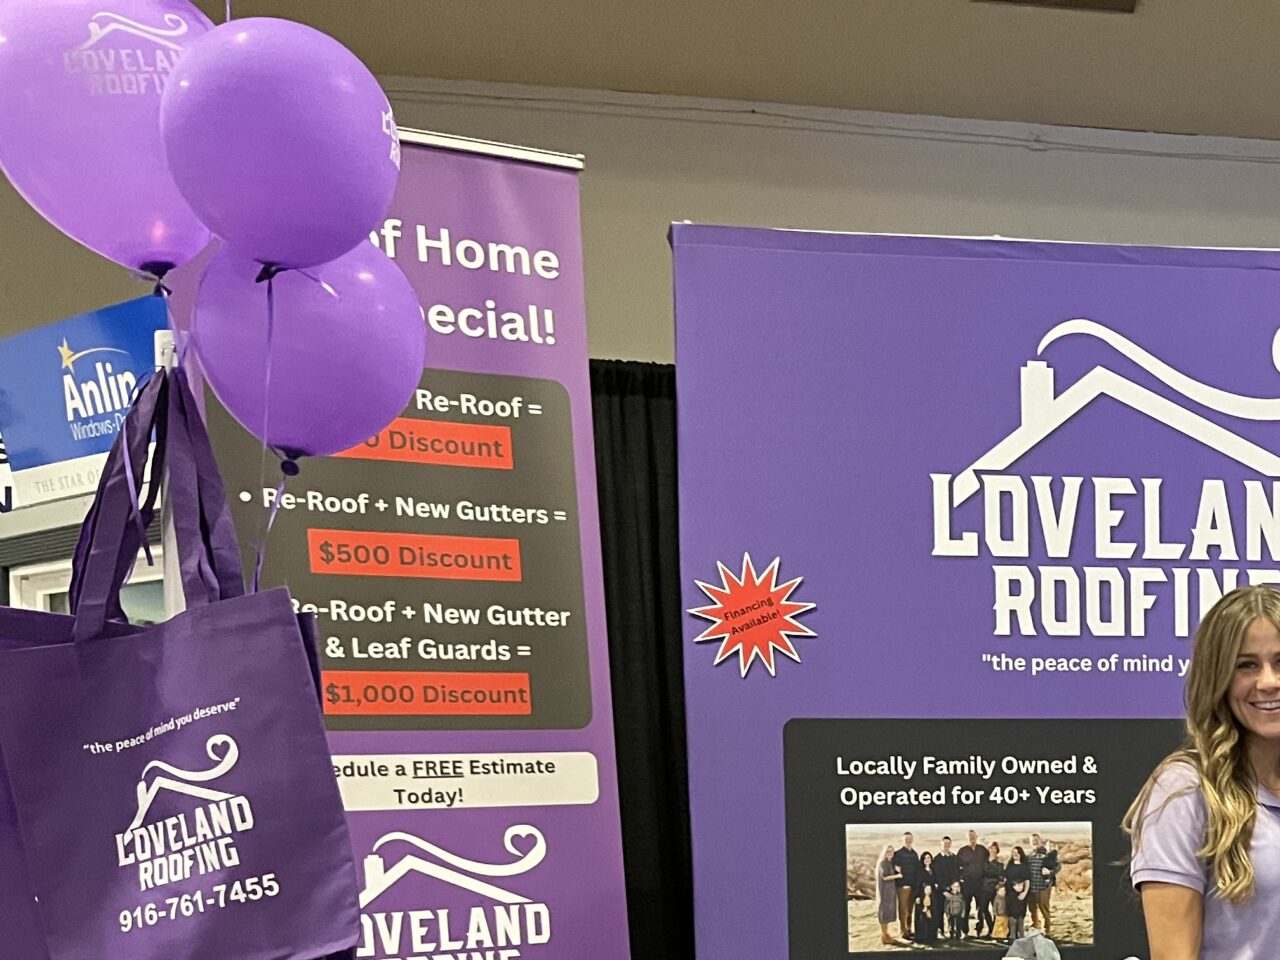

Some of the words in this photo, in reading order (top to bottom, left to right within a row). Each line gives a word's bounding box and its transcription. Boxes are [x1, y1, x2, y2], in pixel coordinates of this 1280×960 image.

[416, 224, 560, 279] Home
[419, 300, 556, 345] ecial!
[63, 361, 139, 421] Anlin
[415, 389, 522, 418] Re-Roof
[389, 430, 505, 458] Discount
[262, 487, 369, 514] Re-Roof
[395, 496, 450, 519] New
[456, 500, 550, 525] Gutters
[319, 540, 391, 566] $500
[399, 545, 514, 572] Discount
[423, 602, 480, 626] New
[487, 604, 571, 628] Gutter
[723, 596, 775, 622] Financing
[730, 609, 781, 636] Available!
[325, 636, 345, 660] &
[352, 636, 411, 660] Leaf
[418, 638, 511, 662] Guards
[1031, 656, 1094, 676] peace
[1097, 653, 1119, 673] of
[1122, 653, 1174, 673] mind
[326, 682, 416, 708] $1,000
[423, 684, 528, 707] Discount
[115, 733, 146, 753] peace
[145, 727, 155, 741] of
[153, 717, 176, 738] mind
[175, 711, 193, 731] you
[395, 764, 407, 777] a
[412, 760, 464, 780] FREE
[469, 758, 556, 776] Estimate
[836, 755, 917, 780] Locally
[922, 755, 996, 780] Family
[1001, 755, 1078, 776] Owned
[1082, 755, 1099, 775] &
[393, 787, 465, 808] Today!
[839, 785, 946, 811] Operated
[951, 785, 985, 806] for
[988, 785, 1031, 806] 40+
[1034, 785, 1097, 805] Years
[114, 794, 255, 868] LOVELAND
[138, 836, 240, 892] ROOFING
[118, 872, 280, 933] 916-761-7455
